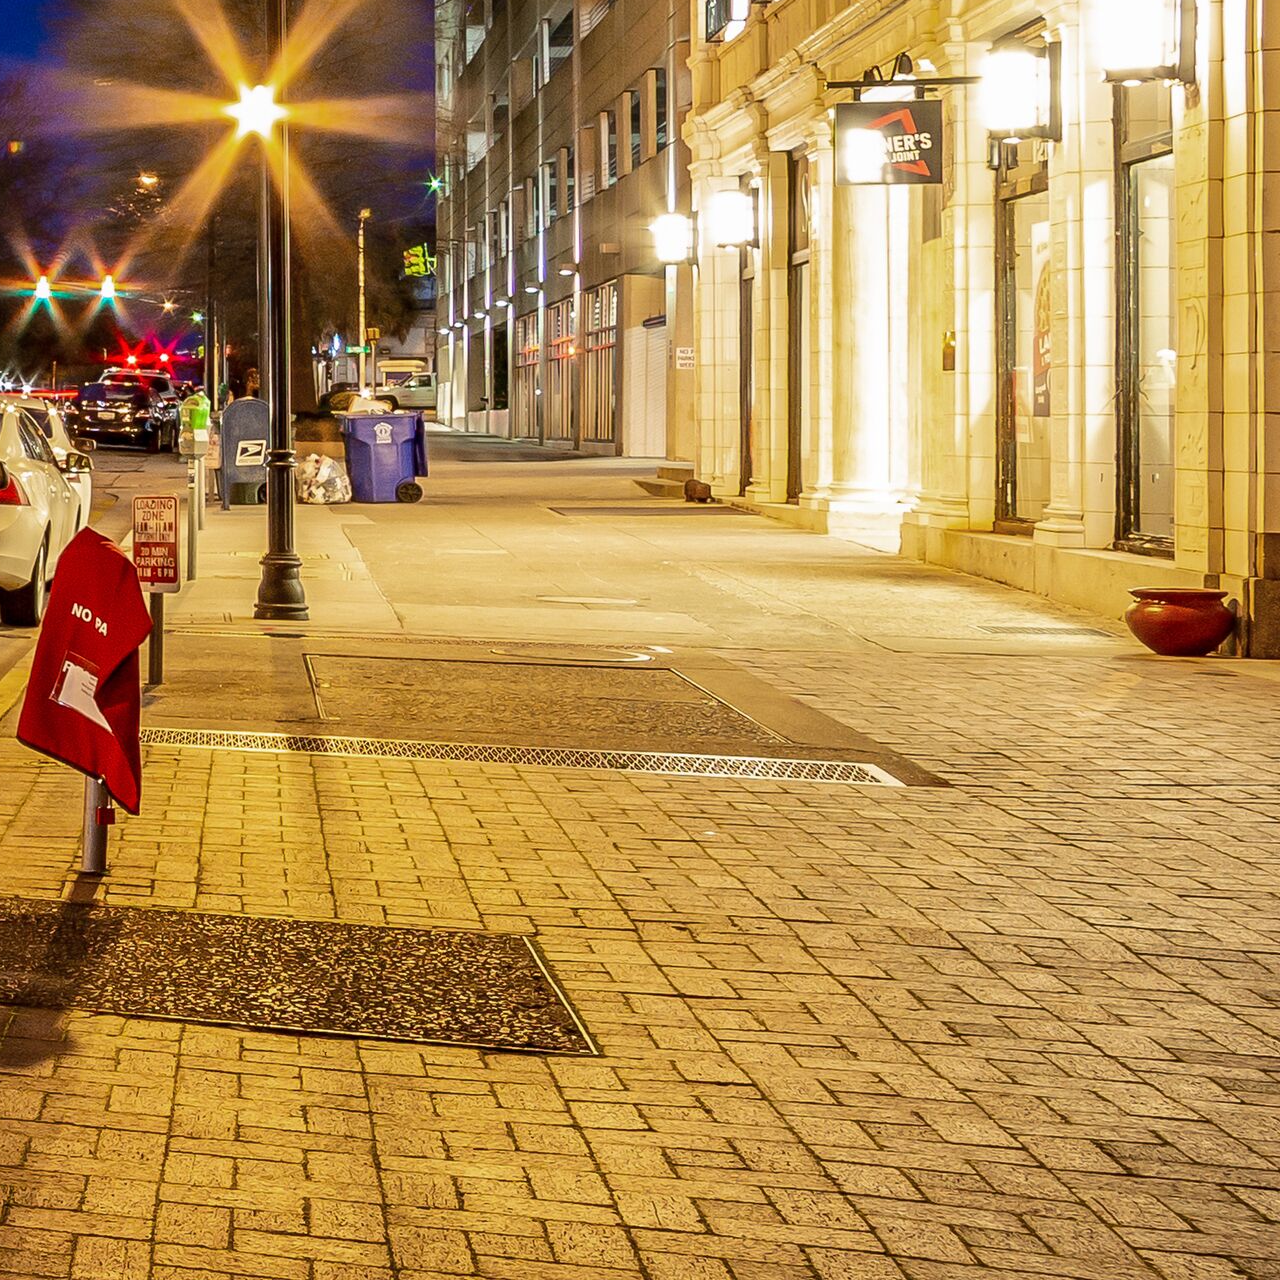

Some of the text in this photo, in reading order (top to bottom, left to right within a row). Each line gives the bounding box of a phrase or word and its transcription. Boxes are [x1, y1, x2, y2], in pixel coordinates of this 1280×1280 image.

[891, 150, 920, 163] JOINT
[136, 500, 173, 510] LOADING
[142, 511, 164, 521] ZONE
[136, 557, 175, 567] PARKING
[71, 603, 92, 622] NO
